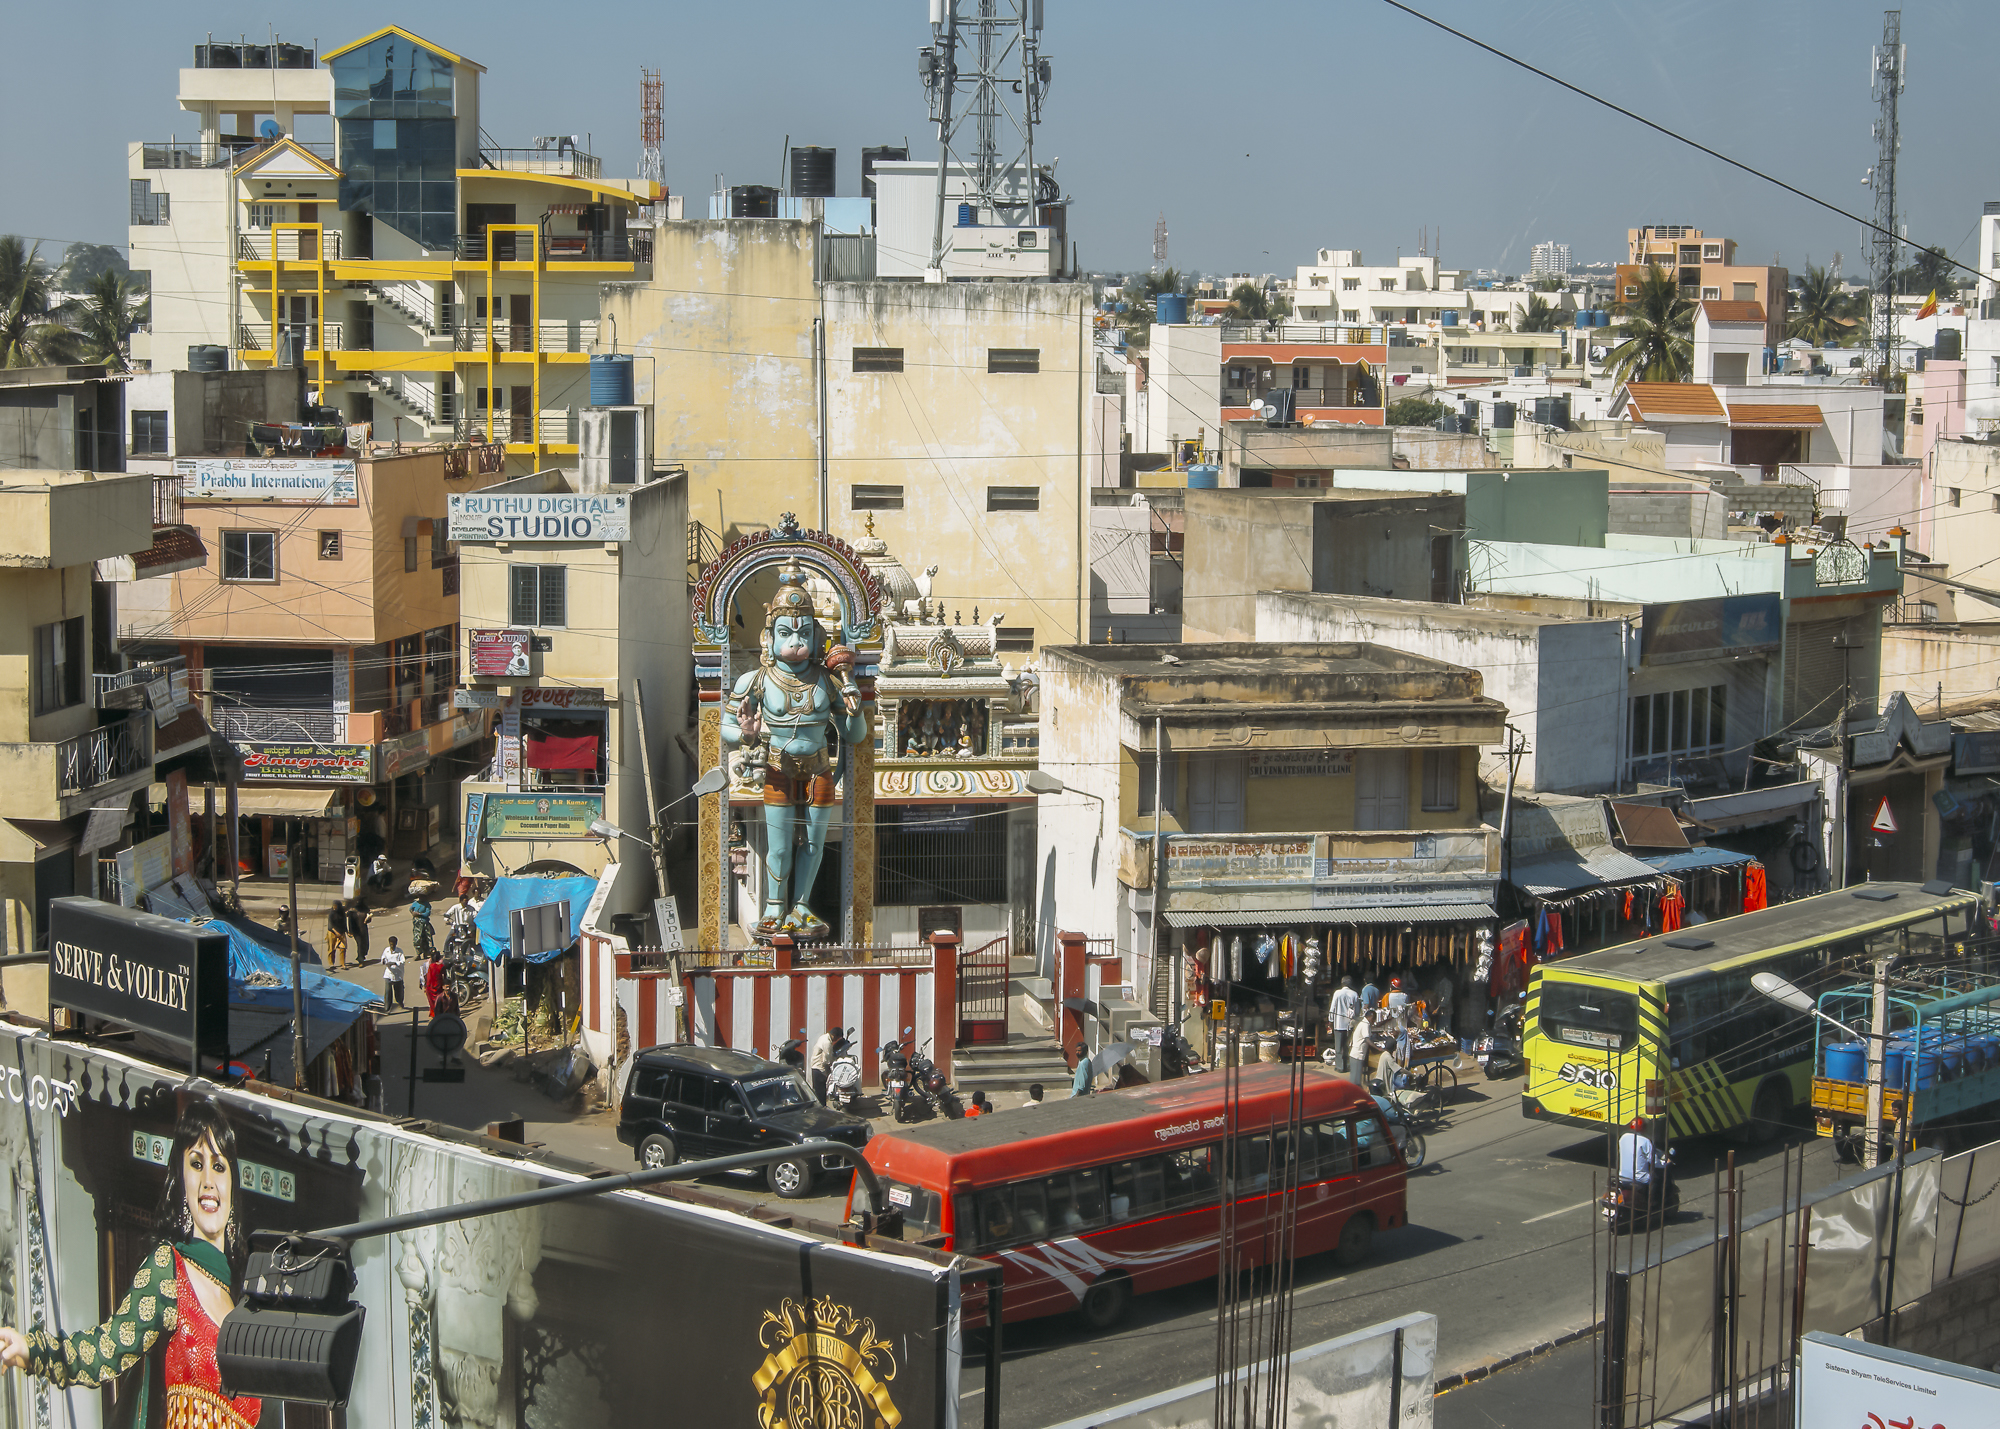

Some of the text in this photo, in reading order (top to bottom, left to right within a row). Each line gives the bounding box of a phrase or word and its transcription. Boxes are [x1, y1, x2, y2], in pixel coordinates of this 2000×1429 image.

[201, 472, 246, 489] Prabhu
[465, 497, 615, 514] RUTHU DIGITAL
[487, 515, 592, 538] STUDIO
[593, 514, 602, 528] 5
[1656, 620, 1719, 636] HERCULES
[498, 630, 528, 643] STUDIO
[457, 697, 498, 708] STUDIO
[244, 753, 368, 769] Anugraha
[1250, 765, 1262, 775] SRI
[1327, 764, 1352, 774] CLINIC
[1575, 832, 1606, 848] STORES
[664, 902, 681, 949] STUDIO
[55, 940, 190, 1012] SERVE & VOLLEY TM
[1779, 1044, 1808, 1059] BMTC
[1154, 1119, 1201, 1142] ಗ್ರಾಮಾಂತರ
[1825, 1362, 1938, 1396] Sistema Shyam TeleServices Limited
